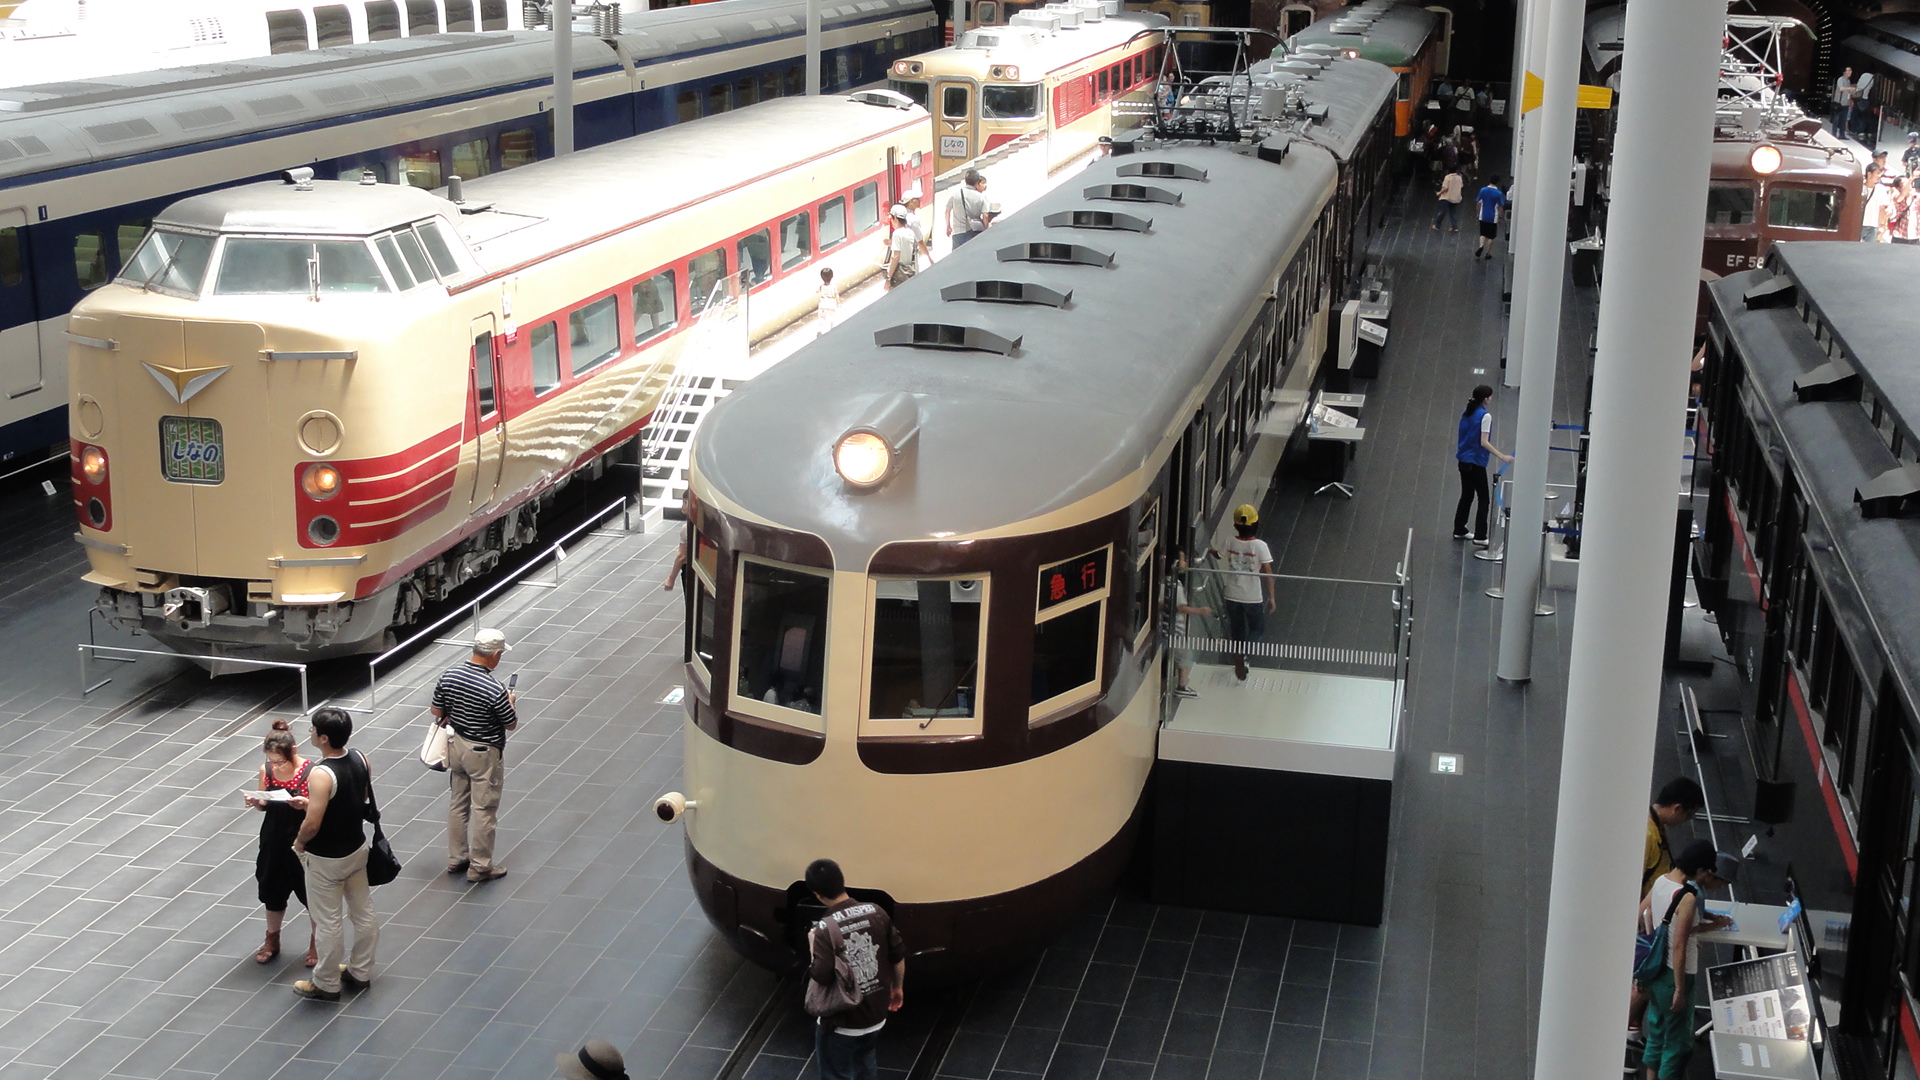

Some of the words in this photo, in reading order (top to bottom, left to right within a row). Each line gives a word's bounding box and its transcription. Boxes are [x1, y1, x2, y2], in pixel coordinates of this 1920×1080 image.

[943, 139, 965, 149] しなの
[1726, 254, 1745, 267] EF
[1748, 256, 1765, 269] 58
[173, 441, 219, 462] しなの
[1050, 562, 1096, 601] 急行
